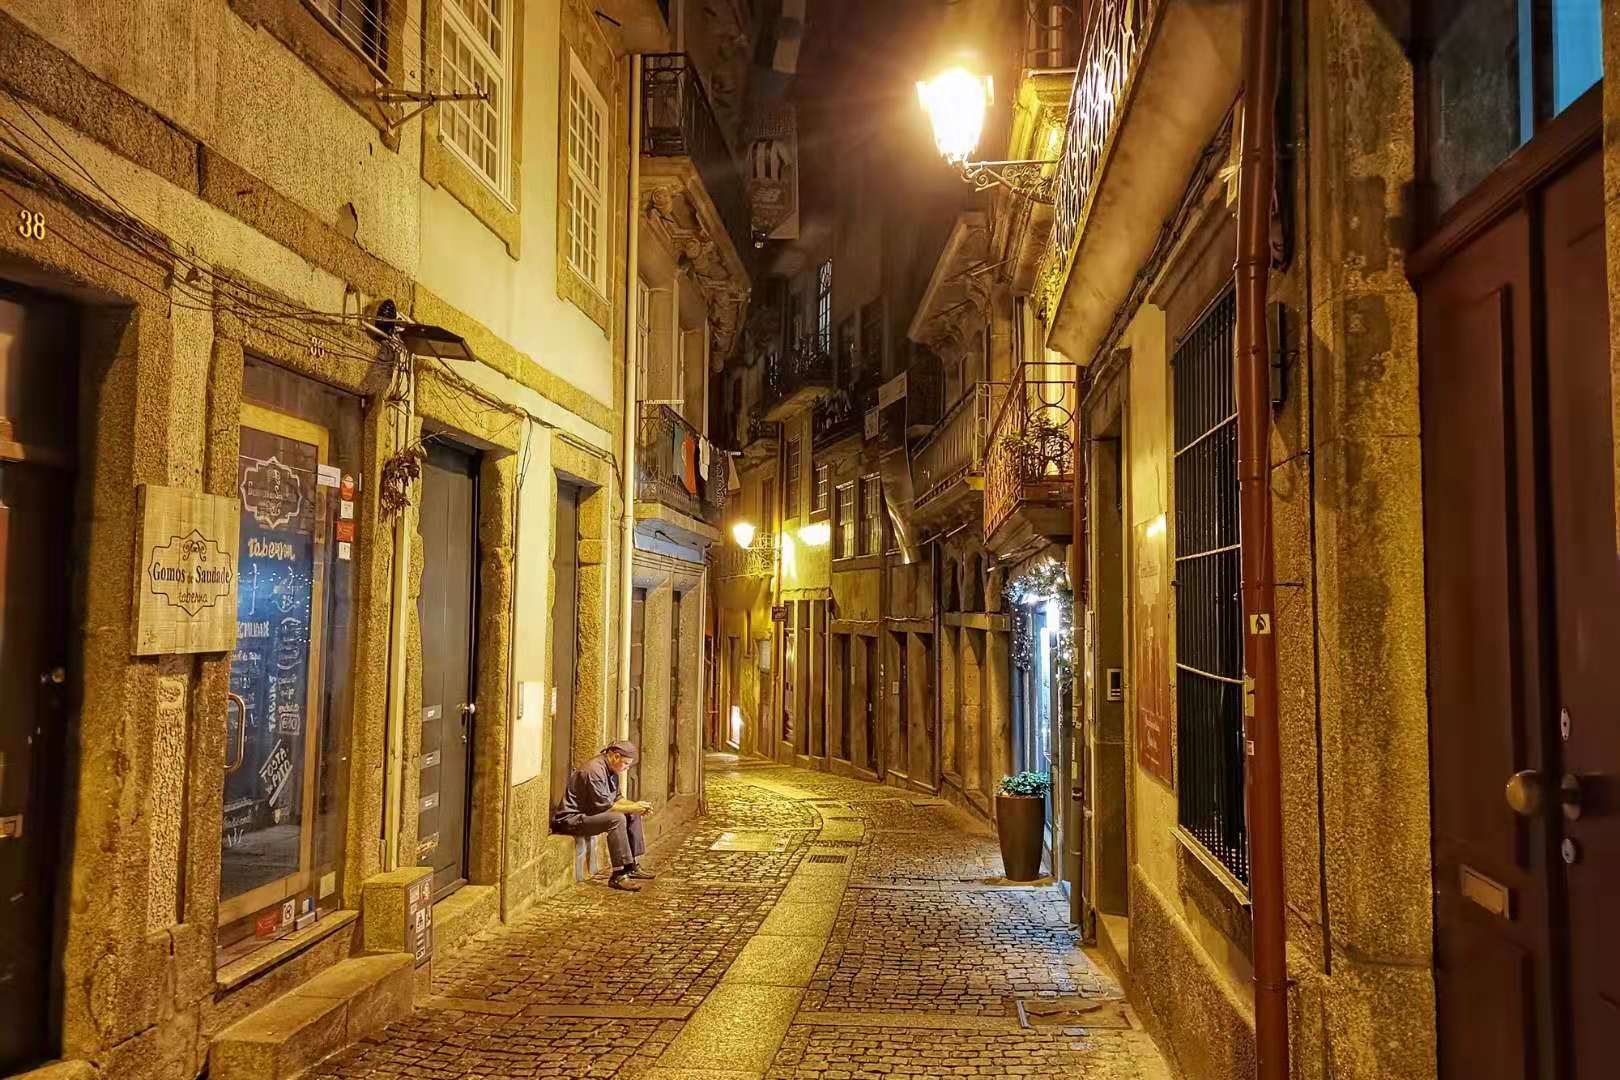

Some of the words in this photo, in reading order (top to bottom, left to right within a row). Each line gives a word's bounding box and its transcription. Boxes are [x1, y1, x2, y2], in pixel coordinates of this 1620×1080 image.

[19, 209, 46, 240] 38
[152, 561, 186, 584] Gomos
[187, 574, 194, 584] de
[195, 565, 230, 584] Saudade
[178, 588, 208, 603] taberna
